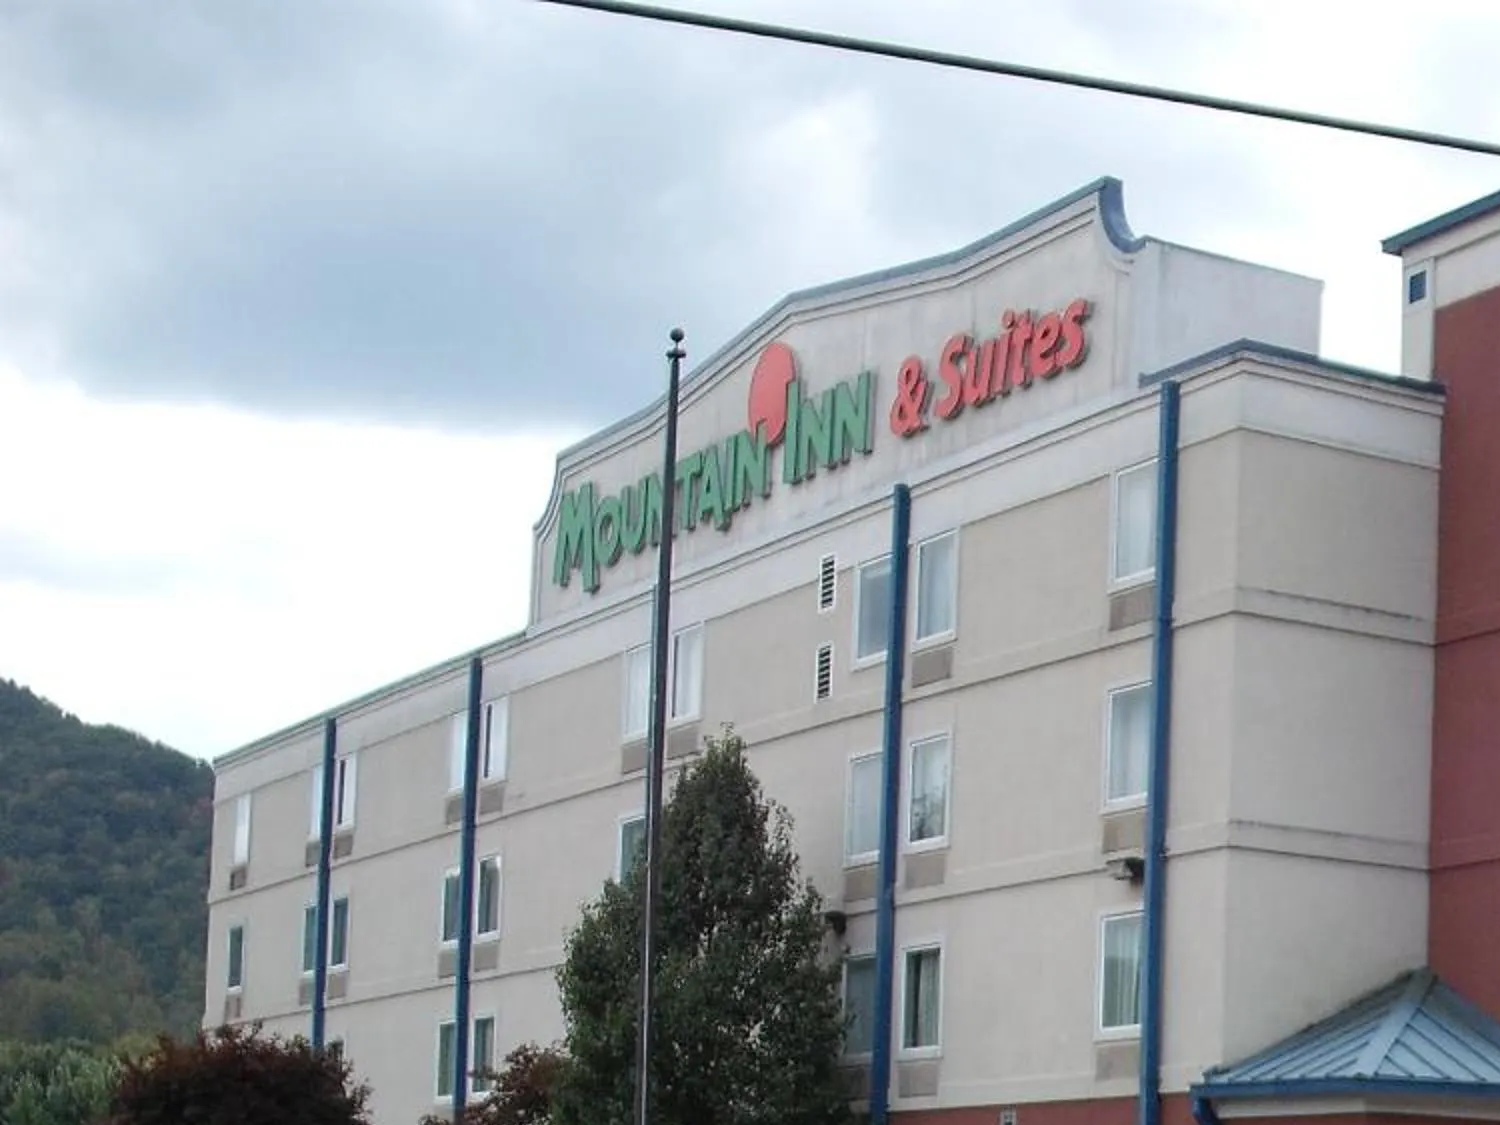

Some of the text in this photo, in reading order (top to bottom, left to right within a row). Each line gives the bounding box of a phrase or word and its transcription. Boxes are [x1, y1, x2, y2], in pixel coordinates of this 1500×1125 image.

[554, 300, 1088, 592] MOUNTAIN INN & Suites
